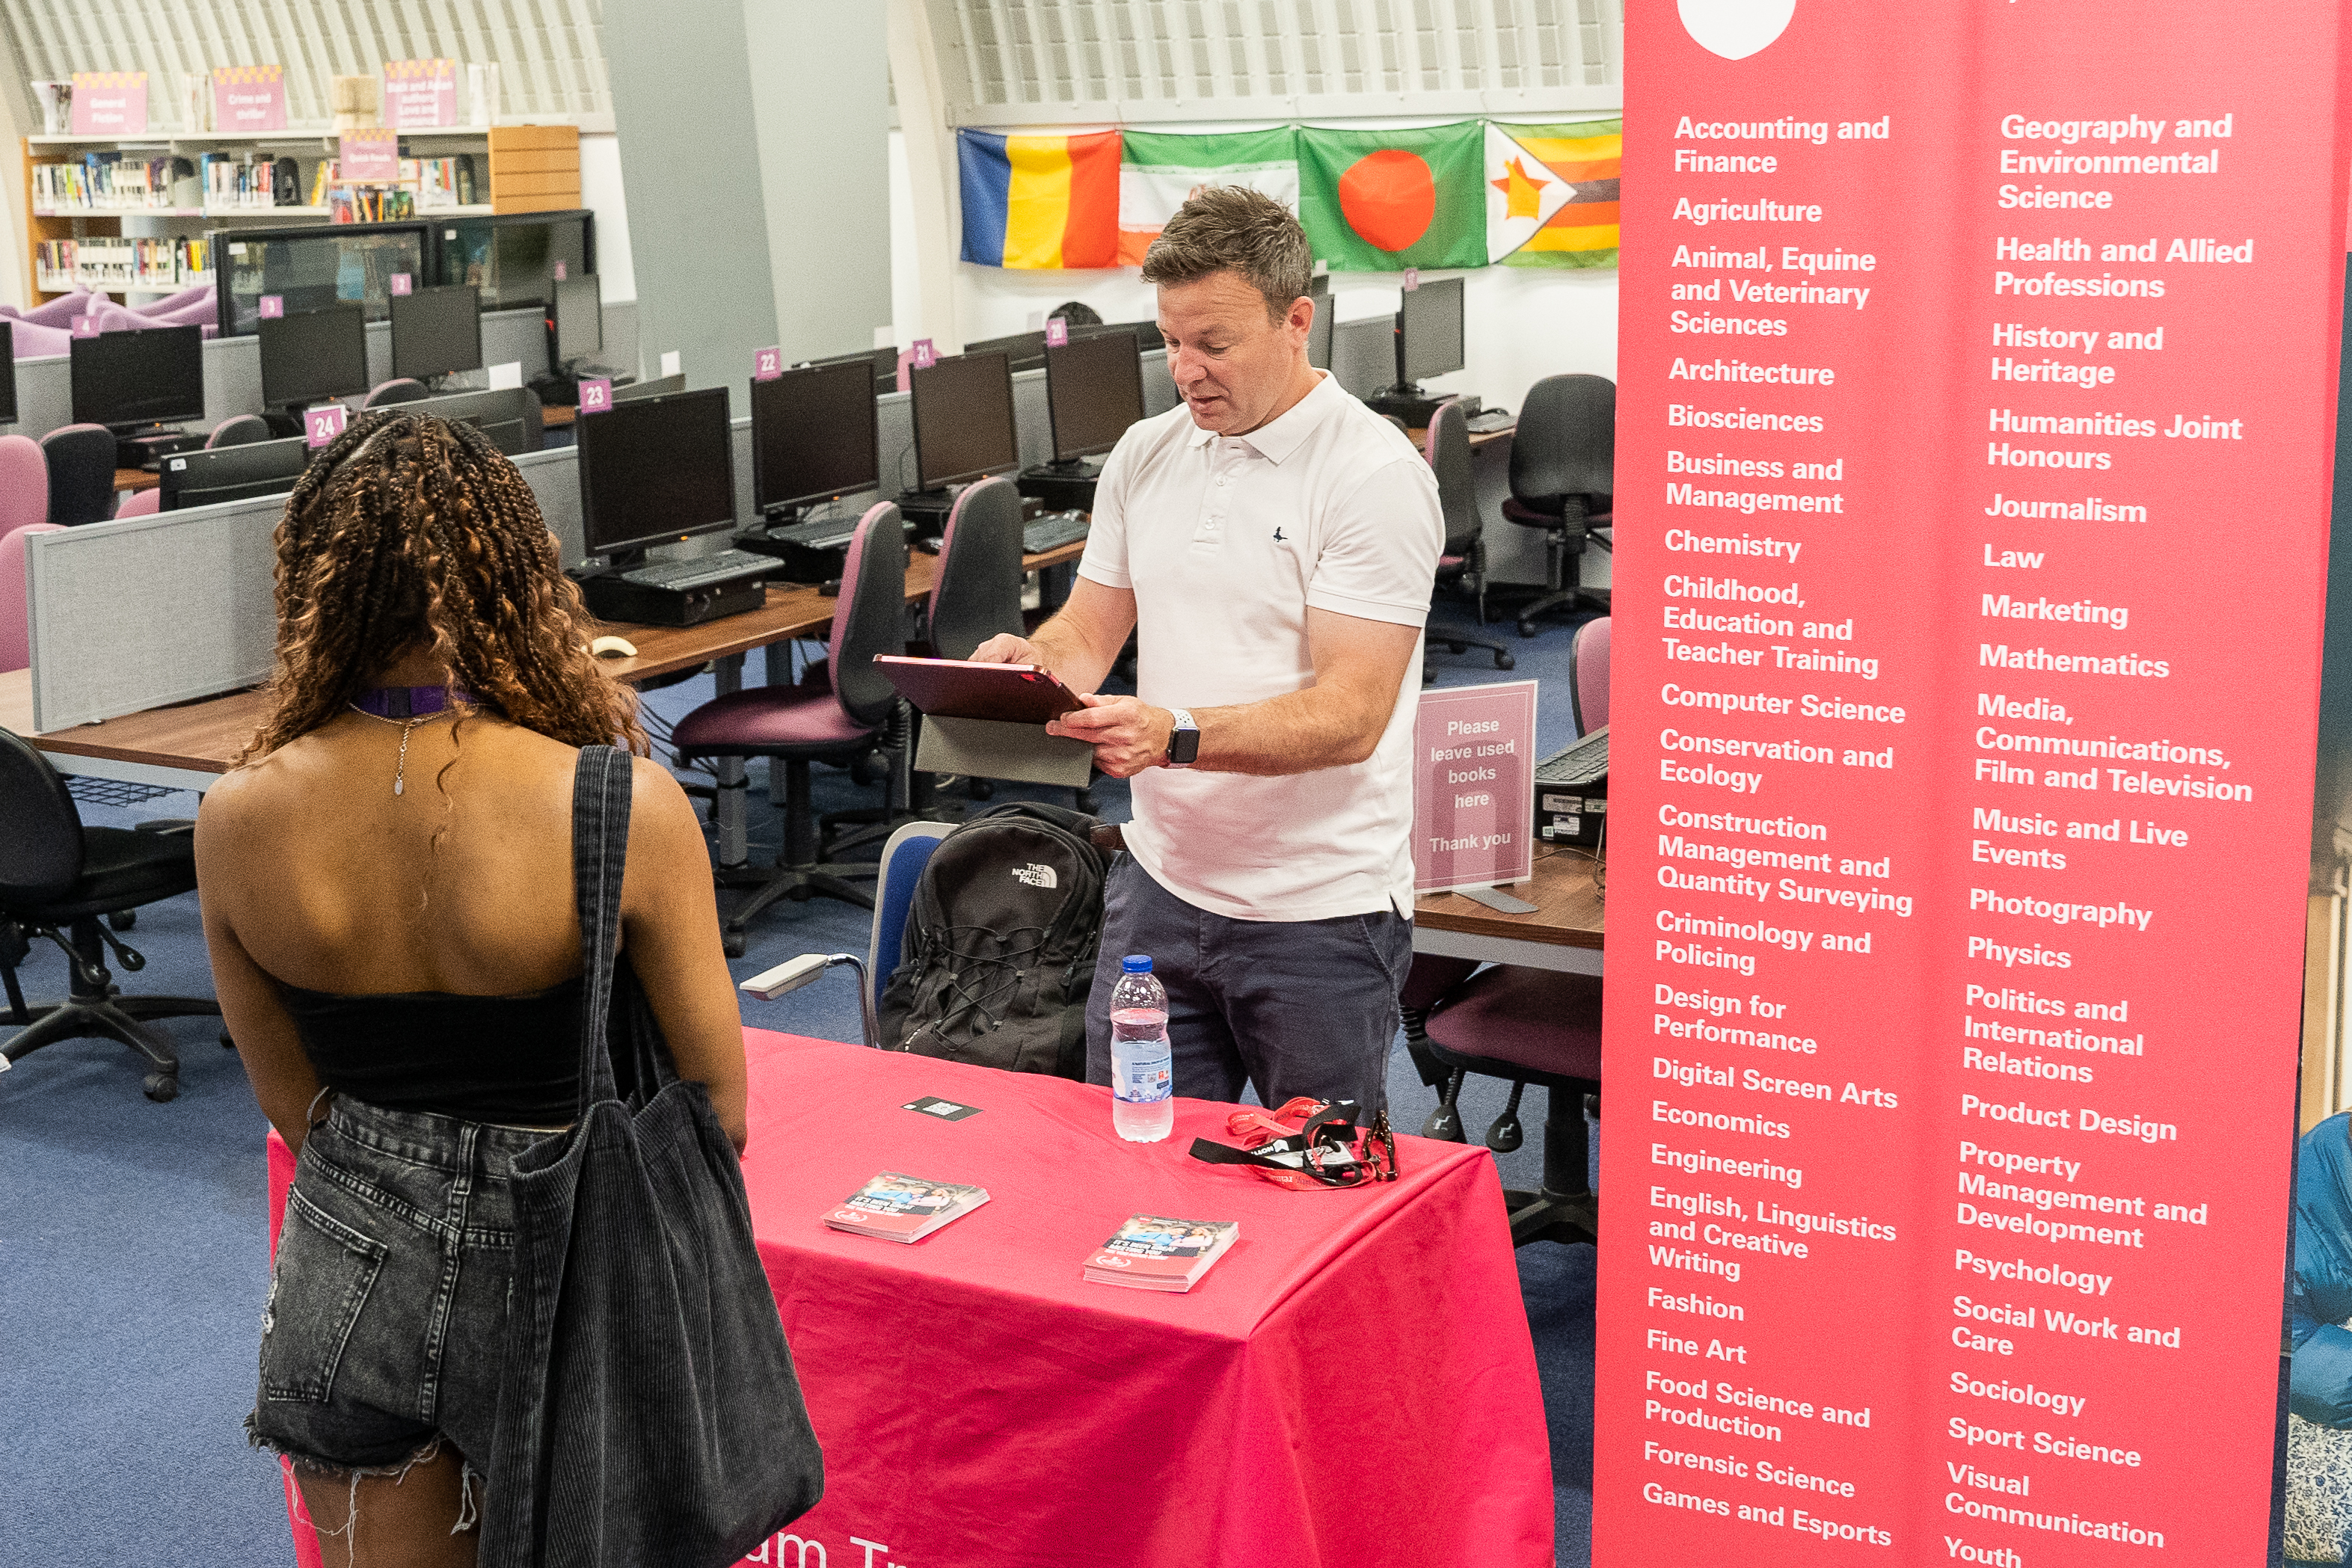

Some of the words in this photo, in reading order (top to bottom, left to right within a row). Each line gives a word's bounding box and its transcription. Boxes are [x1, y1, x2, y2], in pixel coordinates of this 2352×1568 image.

[1674, 116, 1828, 144] Accounting
[1837, 116, 1889, 139] and
[2001, 114, 2166, 144] Geography
[2175, 113, 2232, 138] and
[1675, 150, 1777, 173] Finance
[2001, 149, 2218, 173] Environmental
[1673, 197, 1822, 225] Agriculture
[1998, 185, 2113, 209] Science
[1672, 245, 1772, 272] Animal,
[1782, 247, 1876, 275] Equine
[1997, 237, 2091, 261] Health
[2101, 239, 2157, 262] and
[2165, 239, 2253, 263] Allied
[1671, 279, 1720, 301] and
[1729, 280, 1870, 310] Veterinary
[1995, 271, 2165, 298] Professions
[1671, 310, 1787, 336] Sciences
[1993, 323, 2098, 354] History
[2107, 327, 2163, 350] and
[761, 354, 775, 372] 22
[1669, 357, 1834, 385] Architecture
[1992, 357, 2115, 388] Heritage
[586, 386, 604, 405] 23
[315, 415, 335, 438] 24
[1669, 405, 1823, 432] Biosciences
[1989, 409, 2156, 437] Humanities
[2164, 414, 2243, 440] Joint
[1668, 451, 1784, 478] Business
[1793, 458, 1843, 480] and
[1989, 443, 2111, 470] Honours
[1667, 483, 1843, 514] Management
[1985, 494, 2146, 522] Journalism
[1665, 529, 1801, 563] Chemistry
[1985, 544, 2044, 568] Law
[1664, 575, 1805, 608] Childhood,
[1664, 606, 1793, 636] Education
[1802, 619, 1852, 640] and
[1982, 594, 2128, 630] Marketing
[1662, 638, 1763, 665] Teacher
[1771, 646, 1878, 680] Training
[1980, 644, 2169, 677] Mathematics
[1662, 683, 1793, 714] Computer
[1801, 695, 1906, 723] Science
[1978, 693, 2073, 725] Media,
[1447, 719, 1499, 736] Please
[1431, 746, 1472, 762] leave
[1477, 739, 1514, 757] used
[1661, 729, 1833, 763] Conservation
[1843, 747, 1893, 769] and
[1977, 727, 2230, 769] Communications,
[1448, 766, 1496, 784] books
[1661, 760, 1762, 793] Ecology
[1976, 759, 2034, 784] Film
[2045, 768, 2098, 790] and
[2107, 769, 2252, 802] Television
[1455, 793, 1490, 808] here
[1659, 805, 1826, 840] Construction
[1974, 808, 2057, 836] Music
[2066, 820, 2119, 841] and
[2130, 820, 2188, 846] Live
[1429, 834, 1478, 852] Thank
[1483, 833, 1511, 850] you
[1659, 835, 1831, 873] Management
[1840, 857, 1889, 878] and
[1973, 840, 2066, 870] Events
[1012, 867, 1043, 879] NORTH
[1019, 876, 1043, 887] FACE
[1027, 863, 1044, 872] THE
[1658, 866, 1770, 902] Quantity
[1778, 879, 1912, 917] Surveying
[1971, 888, 2152, 931] Photography
[1656, 910, 1813, 951] Criminology
[1822, 932, 1870, 953] and
[1656, 941, 1754, 976] Policing
[1968, 936, 2071, 968] Physics
[1656, 984, 1741, 1016] Design
[1749, 995, 1786, 1018] for
[1967, 984, 2065, 1016] Politics
[2075, 1000, 2128, 1022] and
[1655, 1014, 1817, 1054] Performance
[1965, 1015, 2143, 1056] International
[1964, 1047, 2092, 1083] Relations
[1654, 1057, 1734, 1086] Digital
[1743, 1069, 1831, 1100] Screen
[1840, 1083, 1897, 1108] Arts
[1653, 1101, 1790, 1138] Economics
[1962, 1095, 2070, 1128] Product
[2080, 1109, 2176, 1143] Design
[1652, 1143, 1802, 1189] Engineering
[1960, 1141, 2081, 1182] Property
[1651, 1186, 1748, 1222] English,
[1757, 1202, 1896, 1240] Linguistics
[1959, 1172, 2145, 1216] Management
[2154, 1204, 2207, 1225] and
[1650, 1221, 1695, 1240] and
[1704, 1224, 1808, 1258] Creative
[1958, 1203, 2143, 1248] Development
[1649, 1245, 1740, 1282] Writing
[1956, 1249, 2112, 1296] Psychology
[1648, 1288, 1743, 1320] Fashion
[1953, 1296, 2035, 1328] Social
[2045, 1310, 2117, 1339] Work
[2128, 1326, 2180, 1348] and
[1648, 1329, 1698, 1356] Fine
[1706, 1339, 1746, 1364] Art
[1952, 1326, 2013, 1355] Care
[1647, 1371, 1707, 1399] Food
[1716, 1383, 1814, 1418] Science
[1823, 1407, 1870, 1427] and
[1950, 1372, 2085, 1416] Sociology
[1646, 1400, 1781, 1442] Production
[1949, 1418, 2024, 1449] Sport
[2033, 1432, 2140, 1466] Science
[1645, 1441, 1748, 1477] Forensic
[1756, 1461, 1855, 1497] Science
[1947, 1462, 2029, 1495] Visual
[1644, 1483, 1730, 1516] Games
[1738, 1505, 1784, 1526] and
[1793, 1510, 1891, 1546] Esports
[1946, 1492, 2164, 1547] Communication
[1944, 1537, 2021, 1568] Youth
